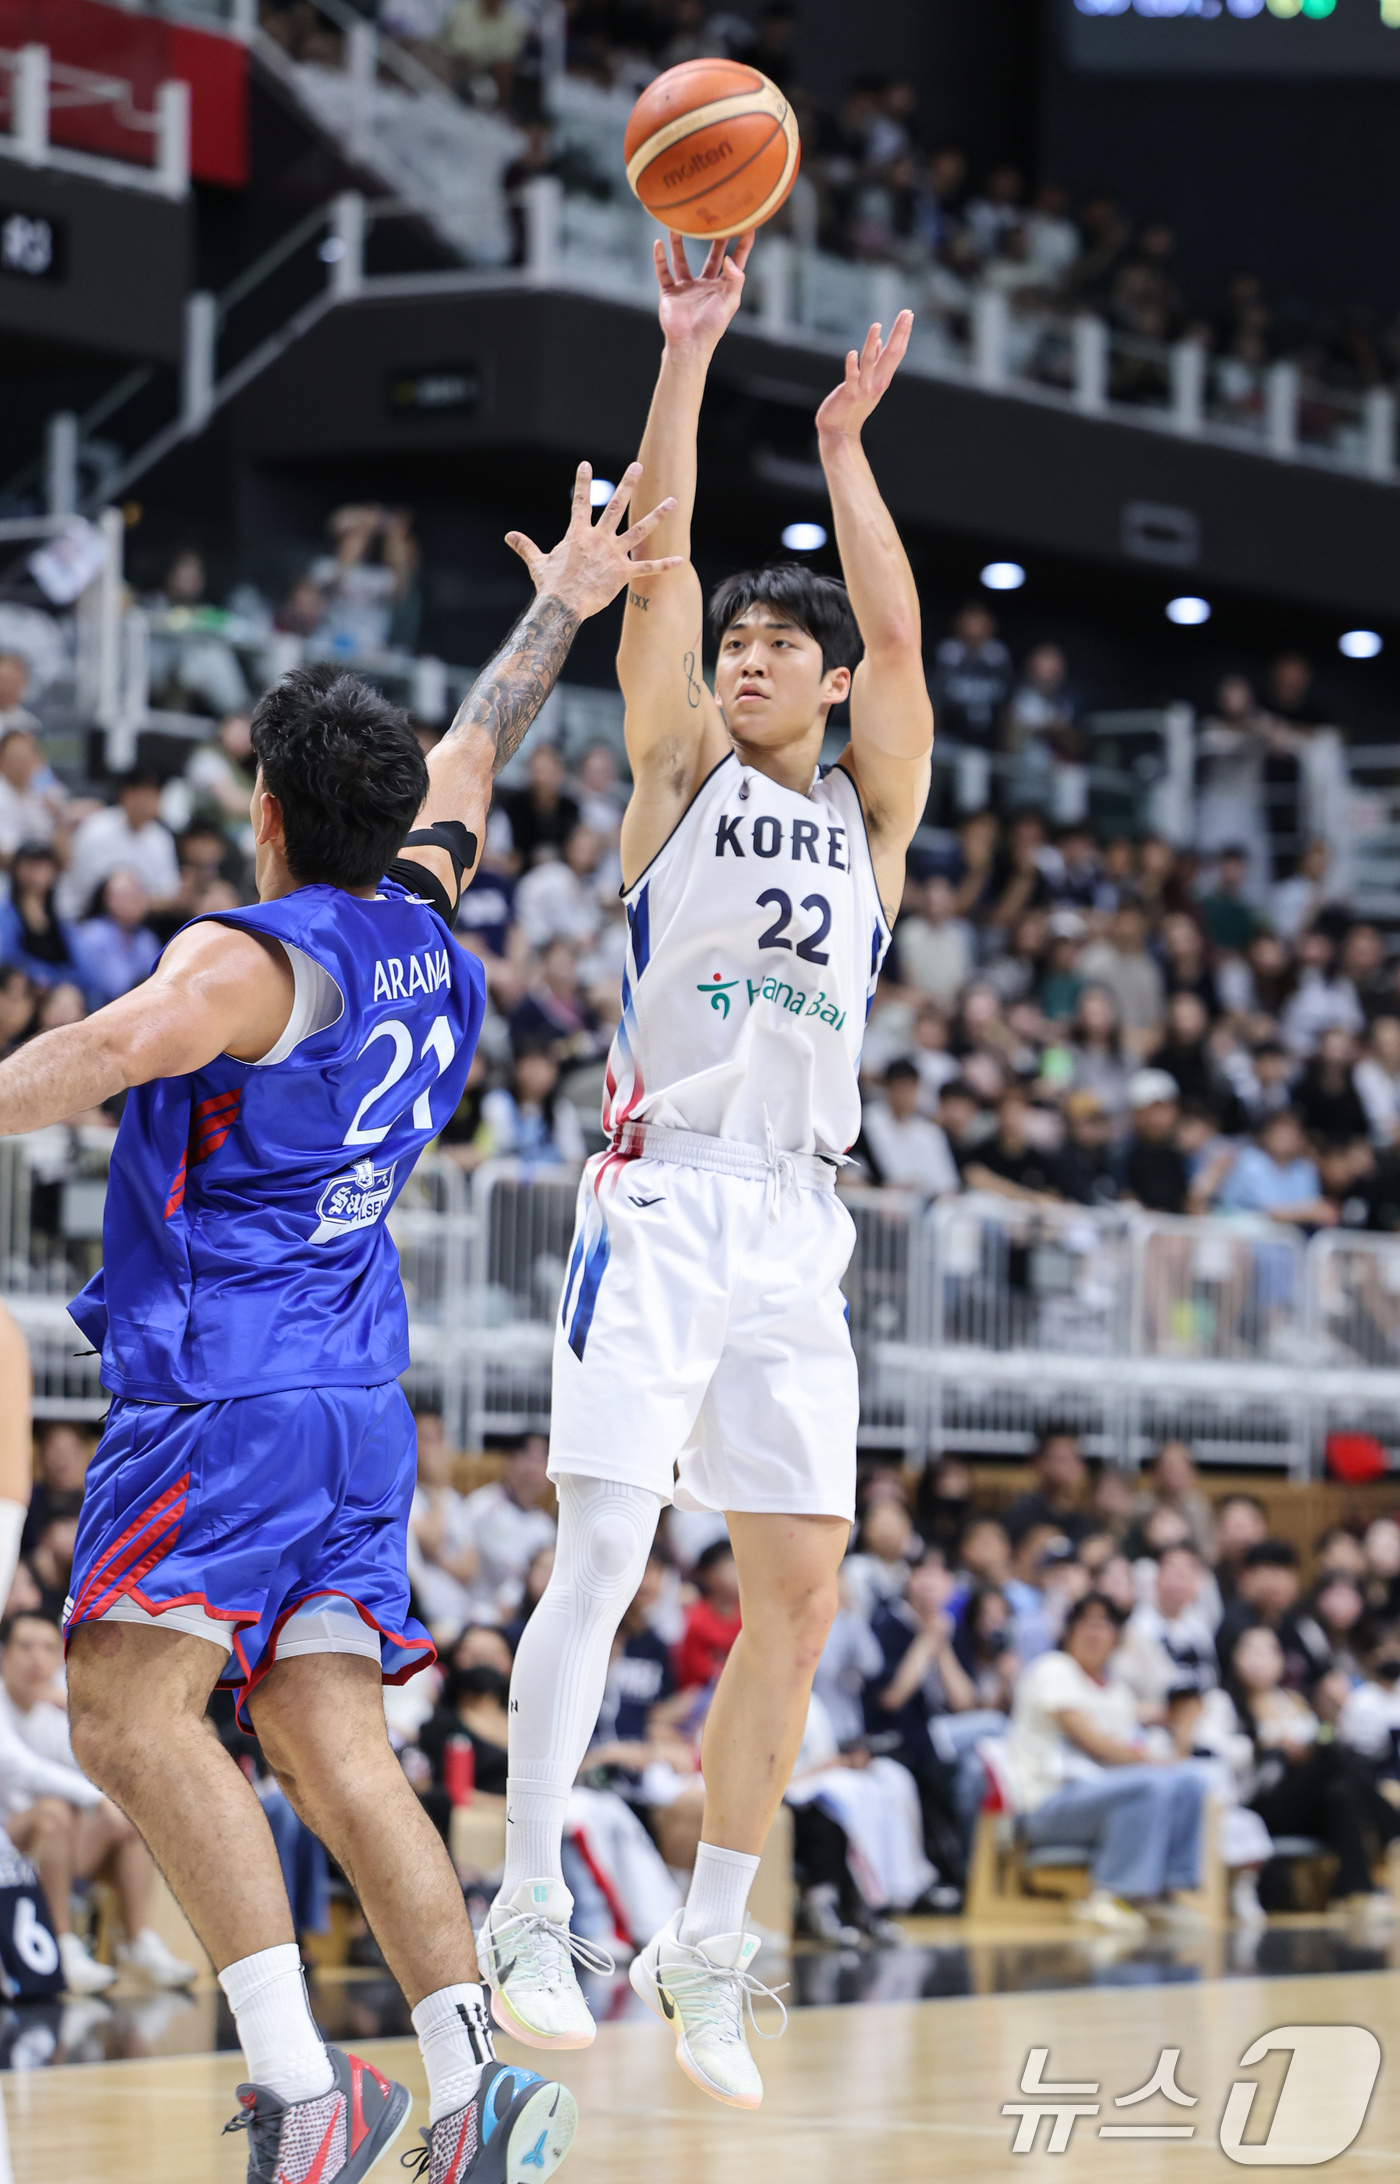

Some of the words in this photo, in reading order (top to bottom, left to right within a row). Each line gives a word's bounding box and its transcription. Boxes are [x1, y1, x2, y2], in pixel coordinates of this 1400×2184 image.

[663, 140, 734, 190] molten
[715, 814, 851, 875] KORE
[755, 887, 832, 967] 22
[373, 948, 451, 1003] ARANA
[342, 1015, 455, 1146] 21
[13, 1897, 59, 1975] 6
